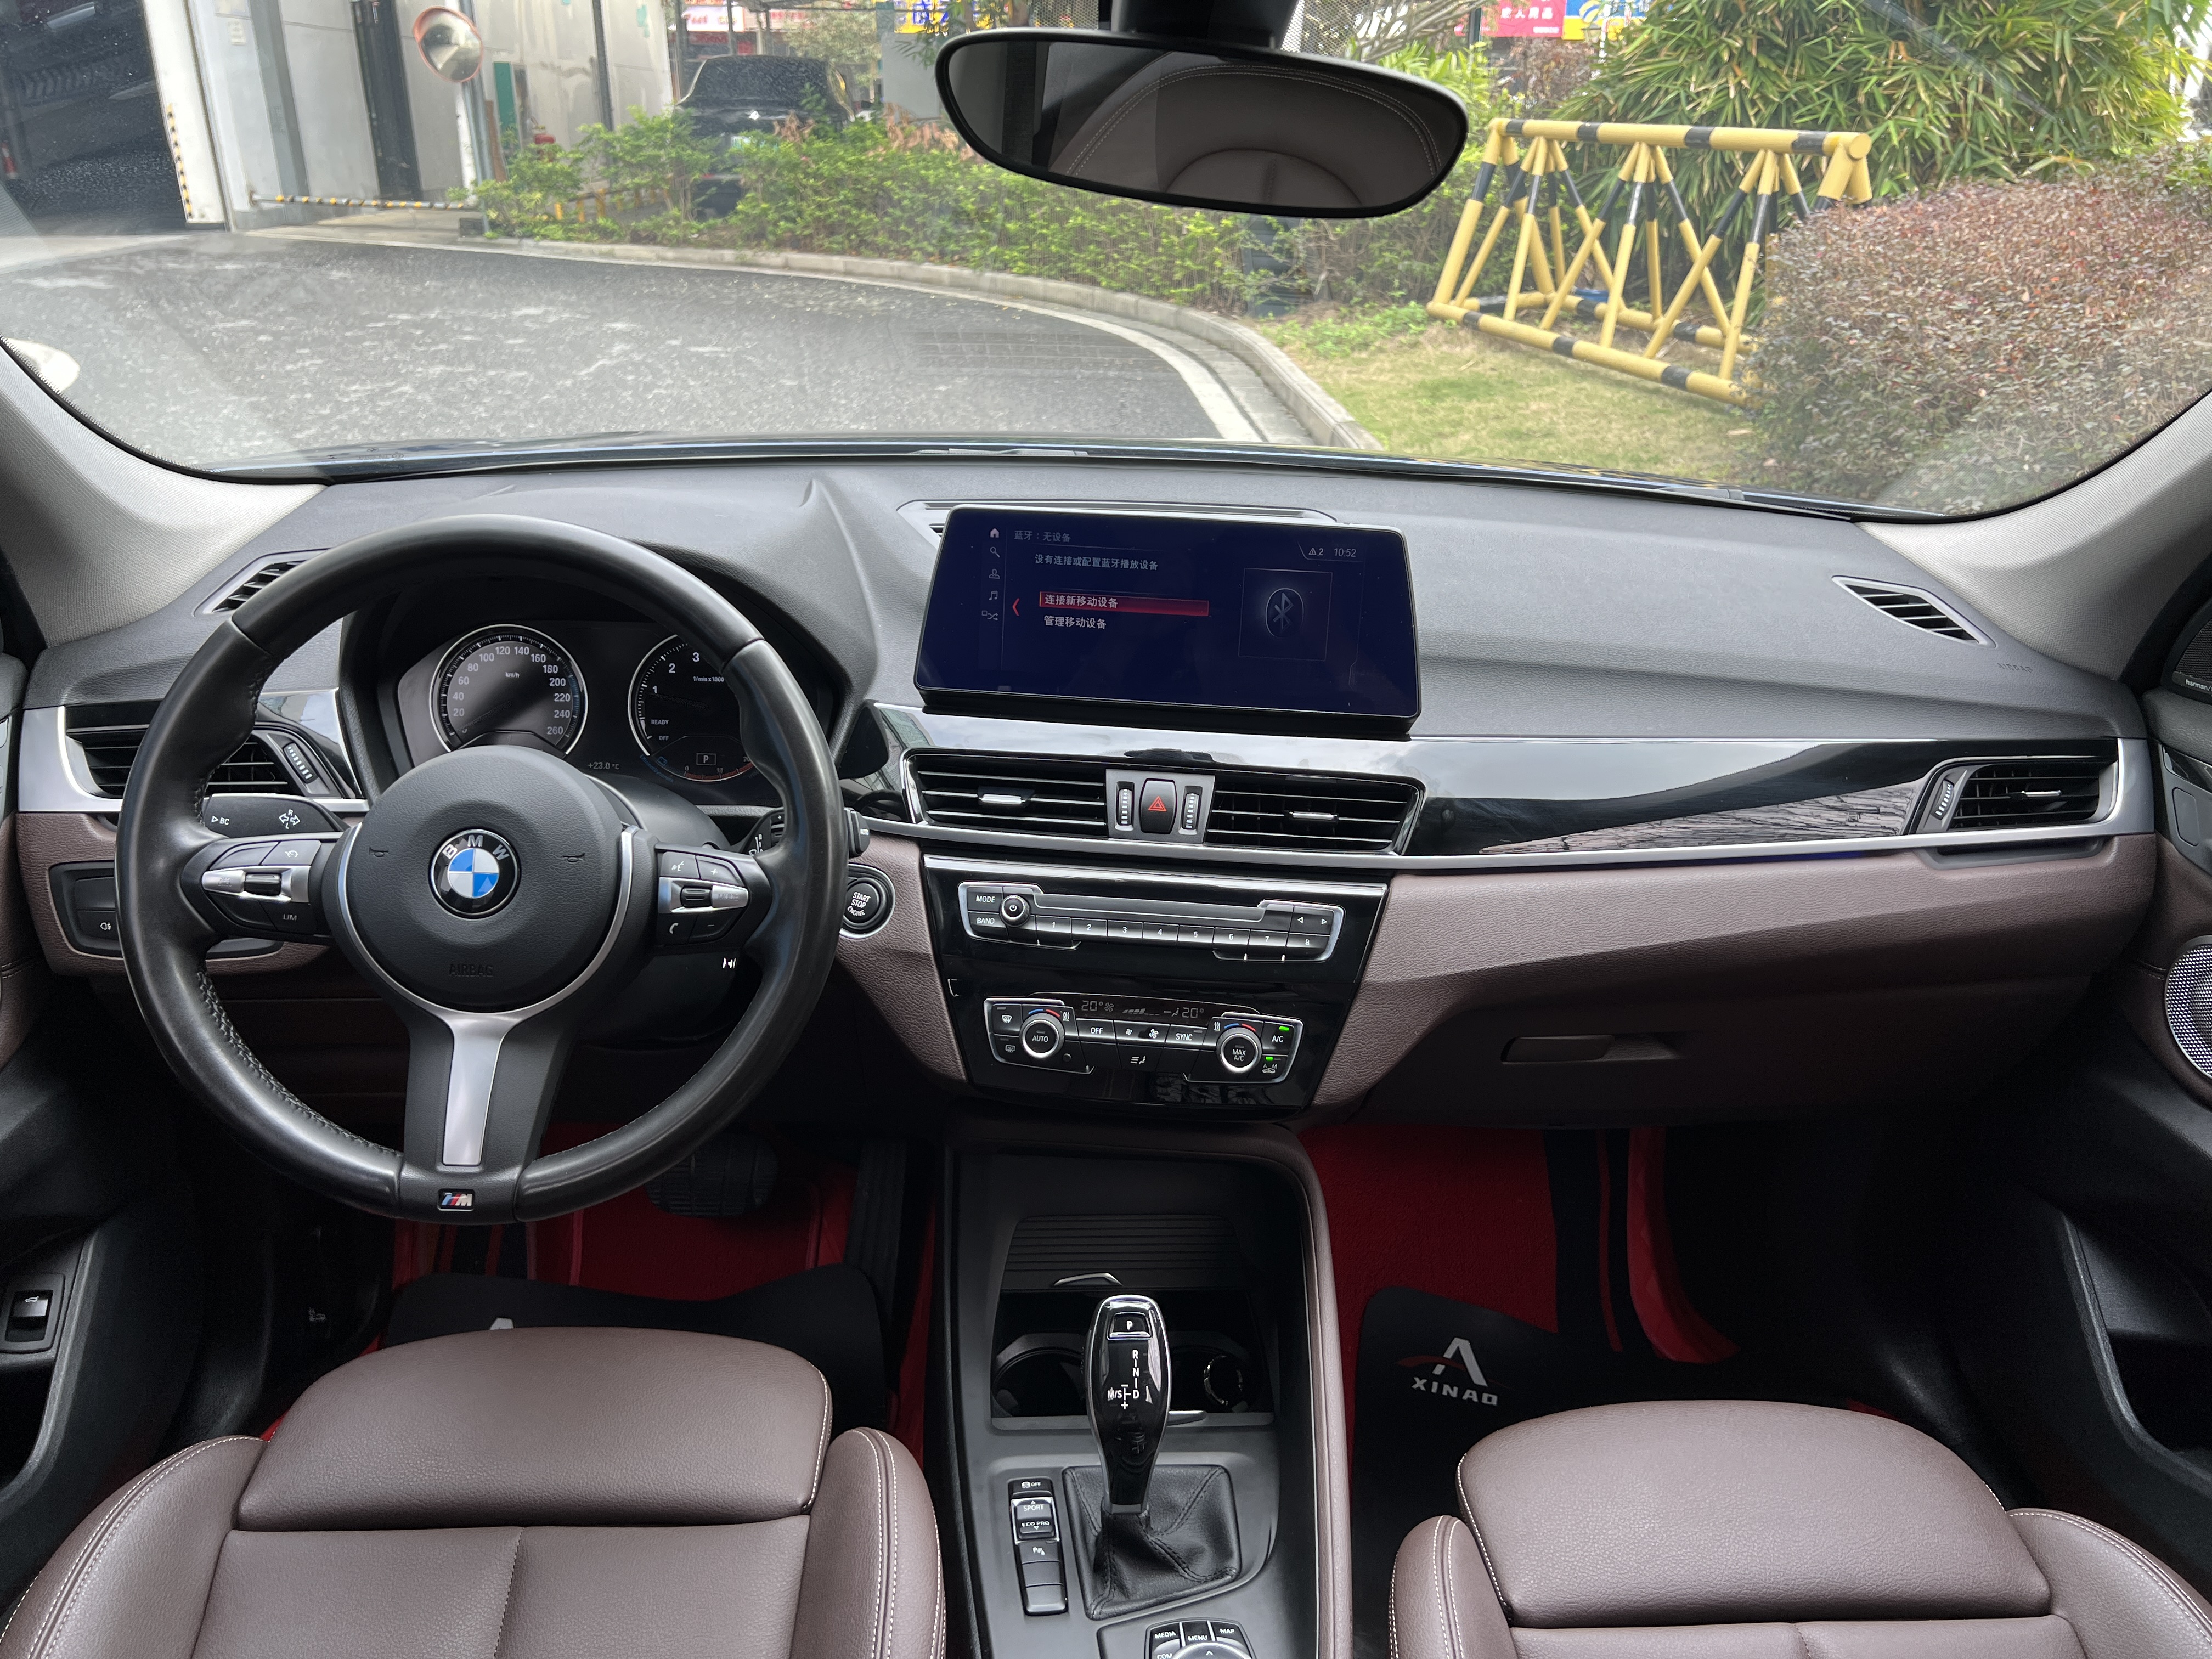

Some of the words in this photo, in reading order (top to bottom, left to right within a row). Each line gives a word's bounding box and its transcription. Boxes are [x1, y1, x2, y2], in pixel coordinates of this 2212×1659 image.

[1334, 548, 1357, 557] 10:52
[1035, 554, 1159, 571] 没有连接或配置蓝牙播放设备
[1045, 594, 1118, 608] 连接新移动设备
[1044, 615, 1107, 629] 管理移动设备
[495, 646, 510, 656] 120
[514, 646, 530, 656] 140
[479, 653, 495, 662] 100
[531, 654, 546, 663] 160
[692, 652, 700, 662] 3
[467, 663, 479, 672] 80
[543, 665, 558, 674] 180
[668, 663, 676, 674] 2
[458, 676, 470, 685] 60
[549, 678, 566, 686] 200
[652, 685, 658, 693] 1
[2186, 679, 2212, 692] harman/
[453, 692, 465, 701] 40
[554, 693, 571, 702] 220
[453, 708, 465, 717] 20
[554, 710, 571, 718] 240
[546, 726, 563, 735] 260
[703, 755, 709, 764] P
[219, 817, 230, 825] BC
[442, 834, 510, 861] BMW
[853, 891, 871, 902] START
[976, 895, 996, 904] MODE
[851, 899, 867, 909] STOP
[847, 905, 866, 917] ENGINE
[448, 963, 494, 977] AIRBAG
[1176, 1033, 1193, 1041] SYNC
[1126, 1321, 1133, 1331] P
[1132, 1350, 1139, 1359] R
[1132, 1367, 1139, 1378] N
[1133, 1390, 1140, 1399] D
[1411, 1376, 1498, 1406] XINAO
[1154, 1630, 1176, 1639] MEDIA
